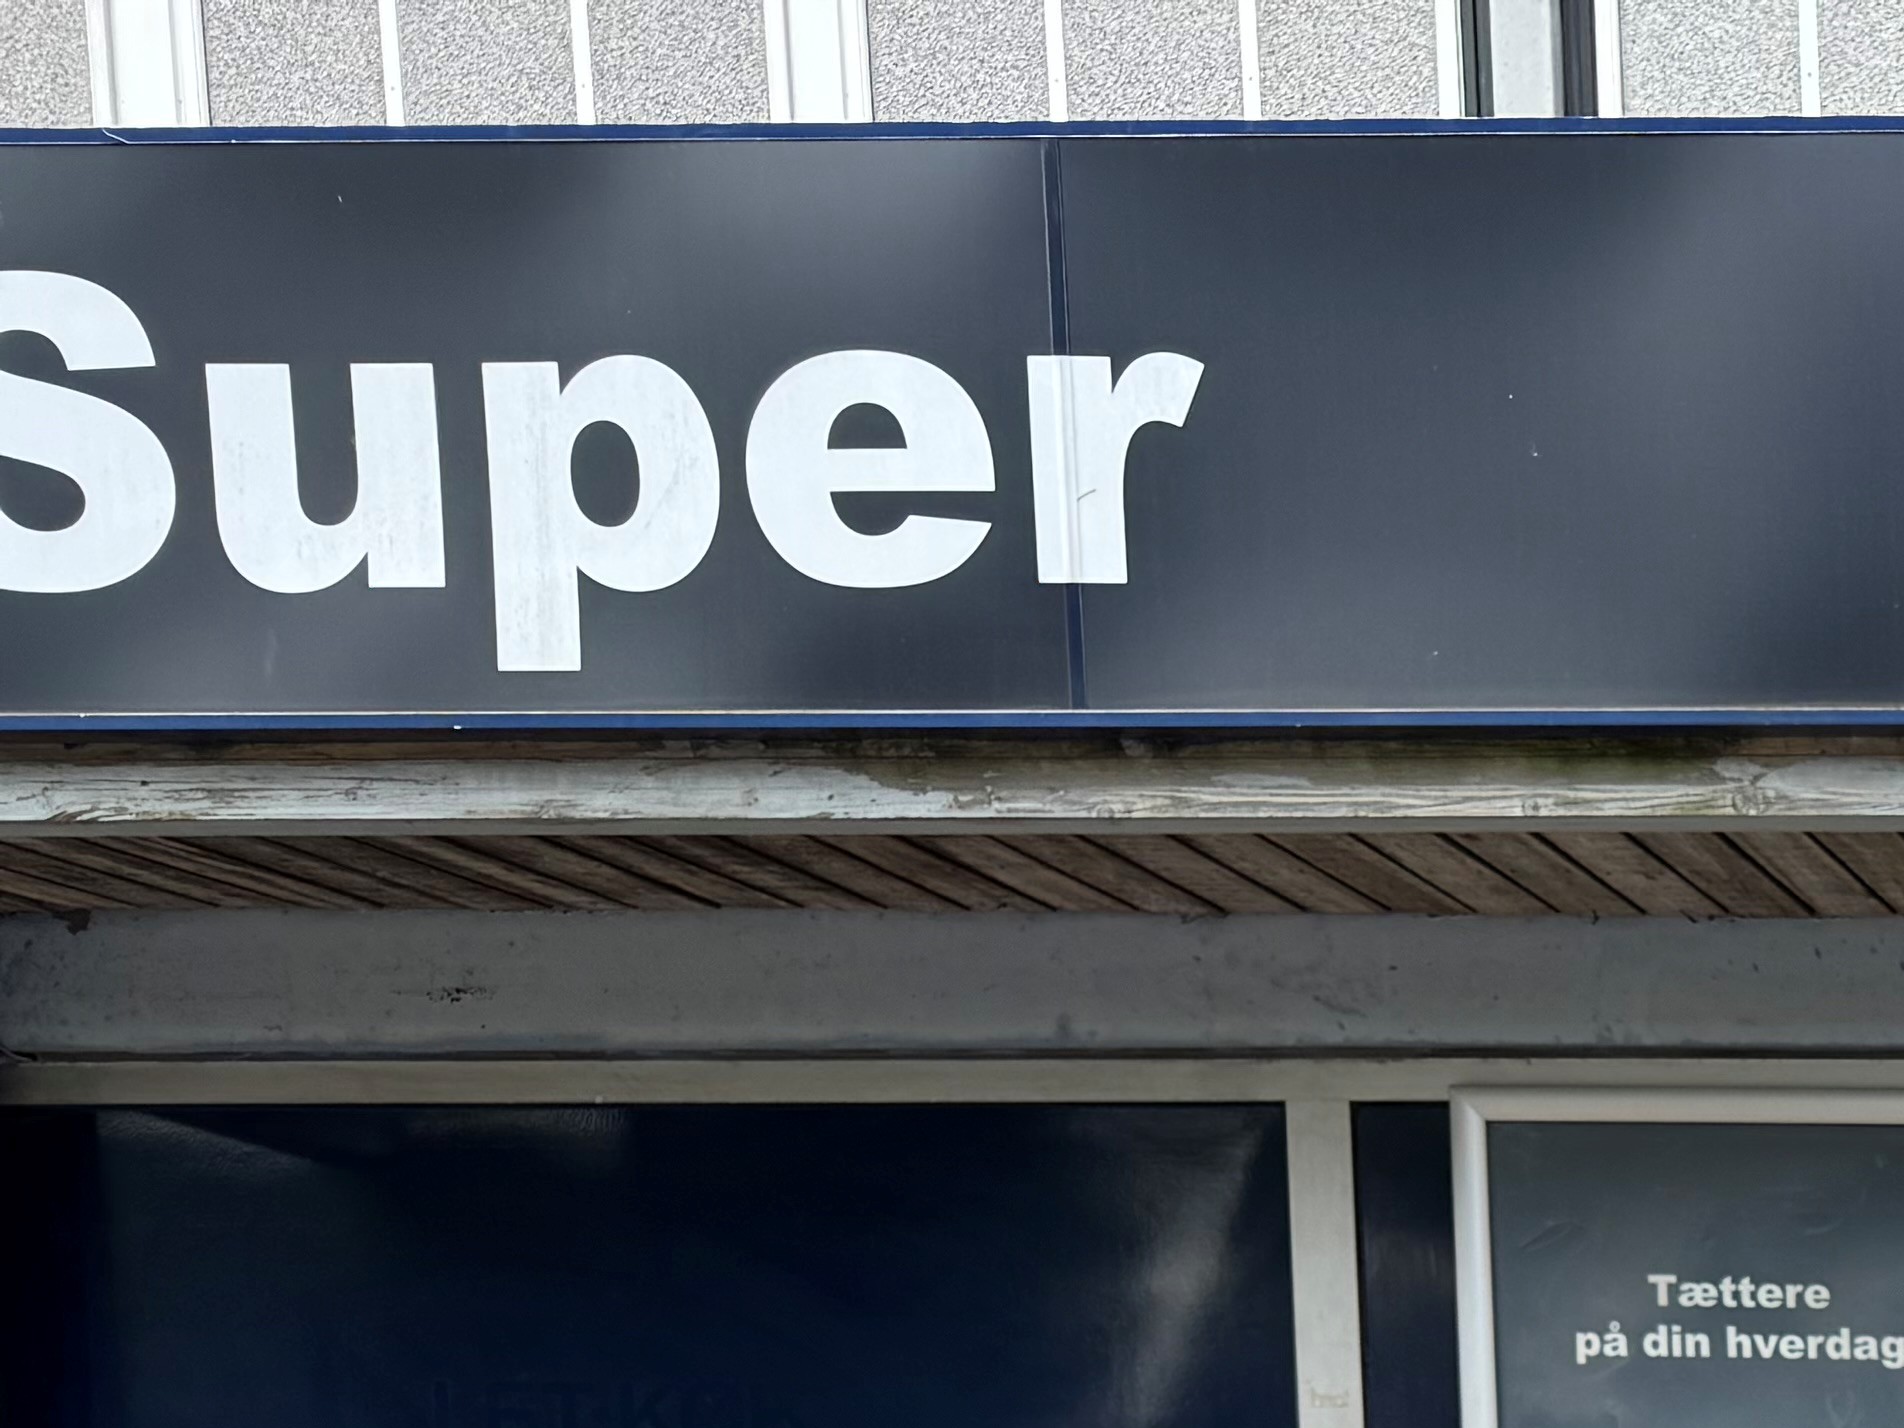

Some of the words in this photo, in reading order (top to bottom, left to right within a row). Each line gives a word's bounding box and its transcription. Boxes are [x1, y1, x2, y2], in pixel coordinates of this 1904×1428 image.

[0, 270, 1204, 672] Super
[1647, 1274, 1831, 1309] Tættere
[1575, 1321, 1628, 1364] på
[1643, 1325, 1710, 1358] din
